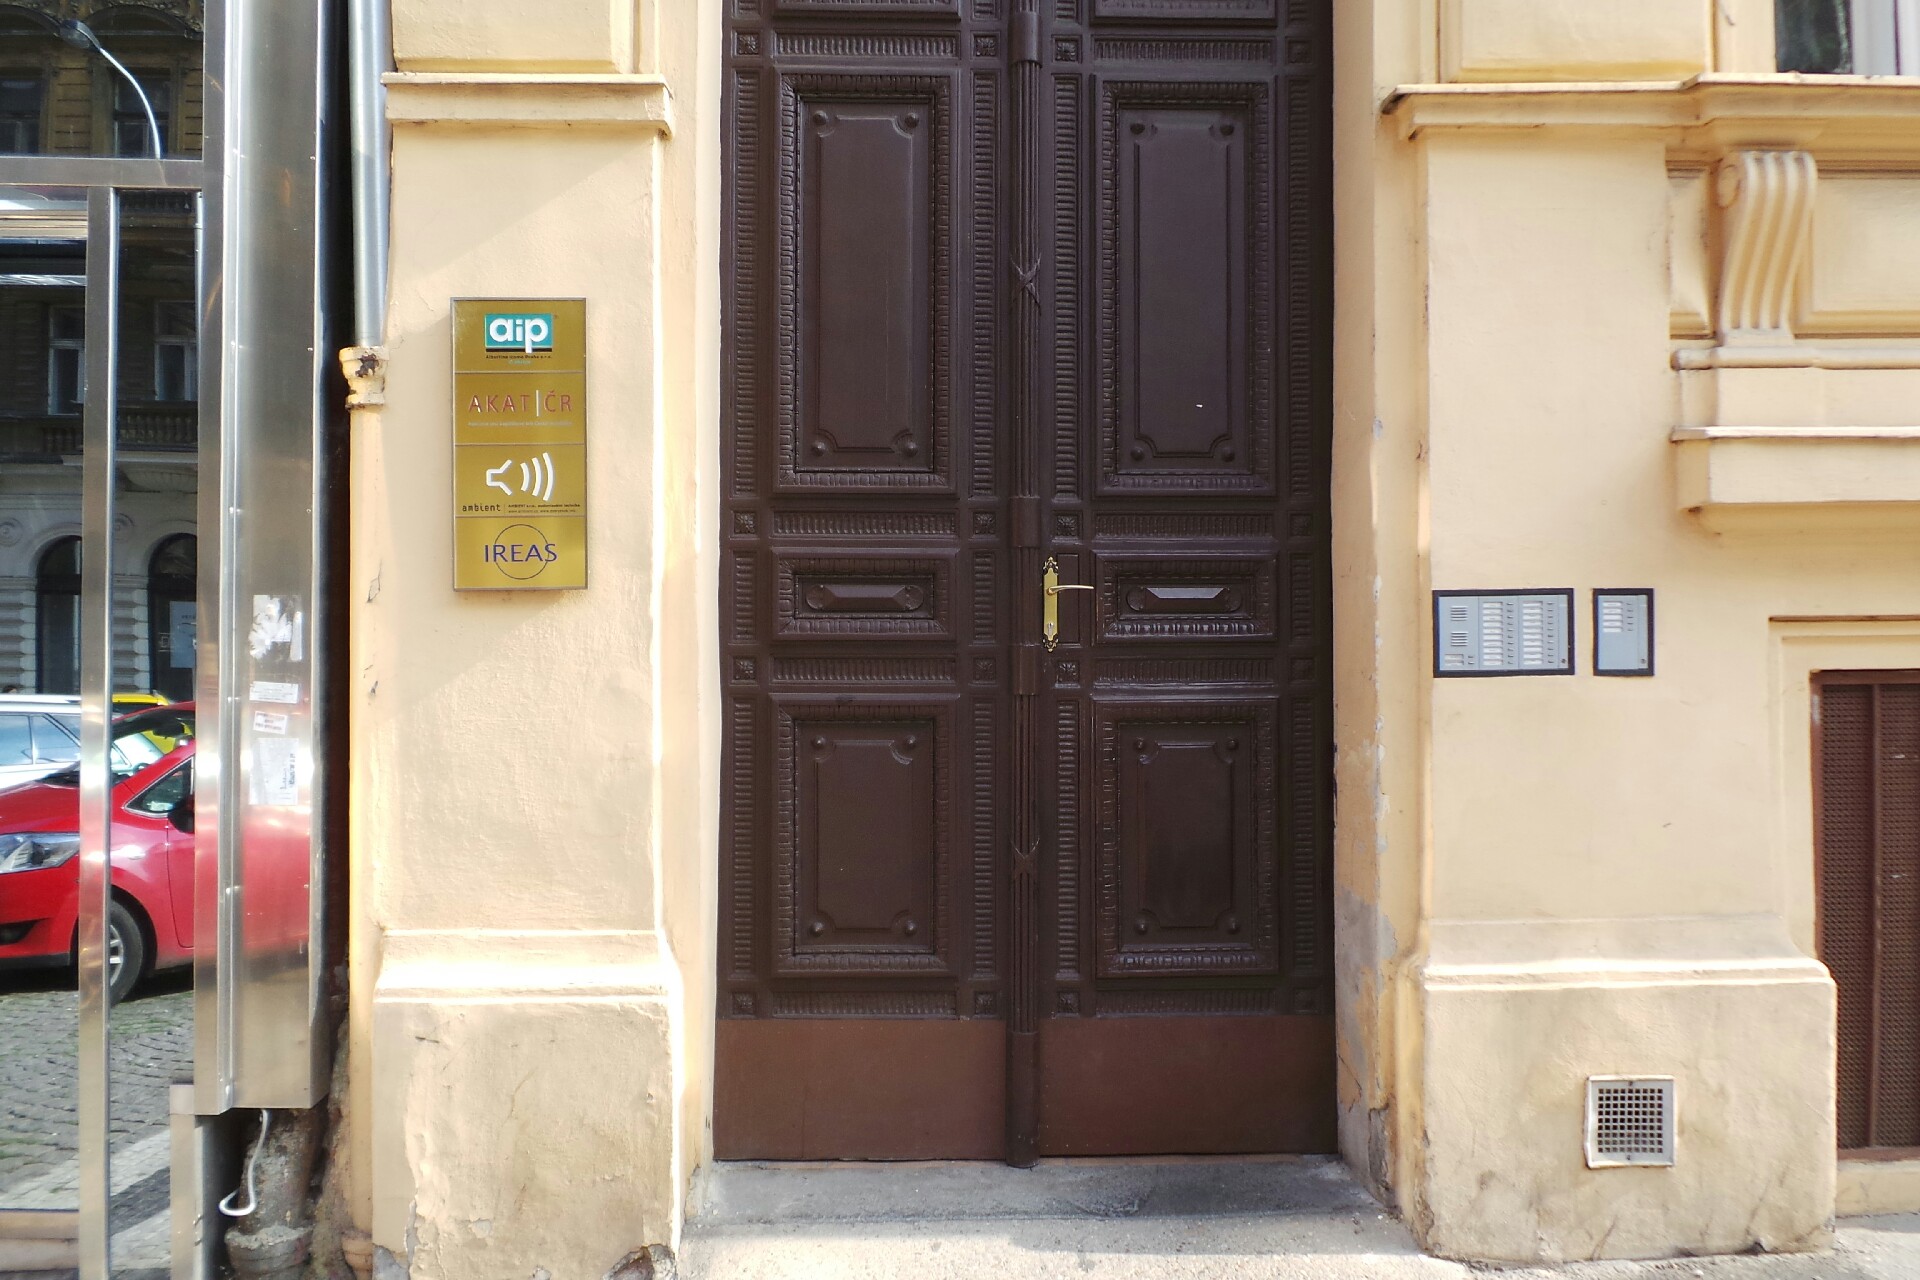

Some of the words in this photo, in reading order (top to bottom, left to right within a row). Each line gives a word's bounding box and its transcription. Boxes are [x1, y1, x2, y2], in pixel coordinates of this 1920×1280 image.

[490, 318, 549, 353] aip
[462, 503, 501, 512] ambient
[484, 543, 558, 563] IREAS
